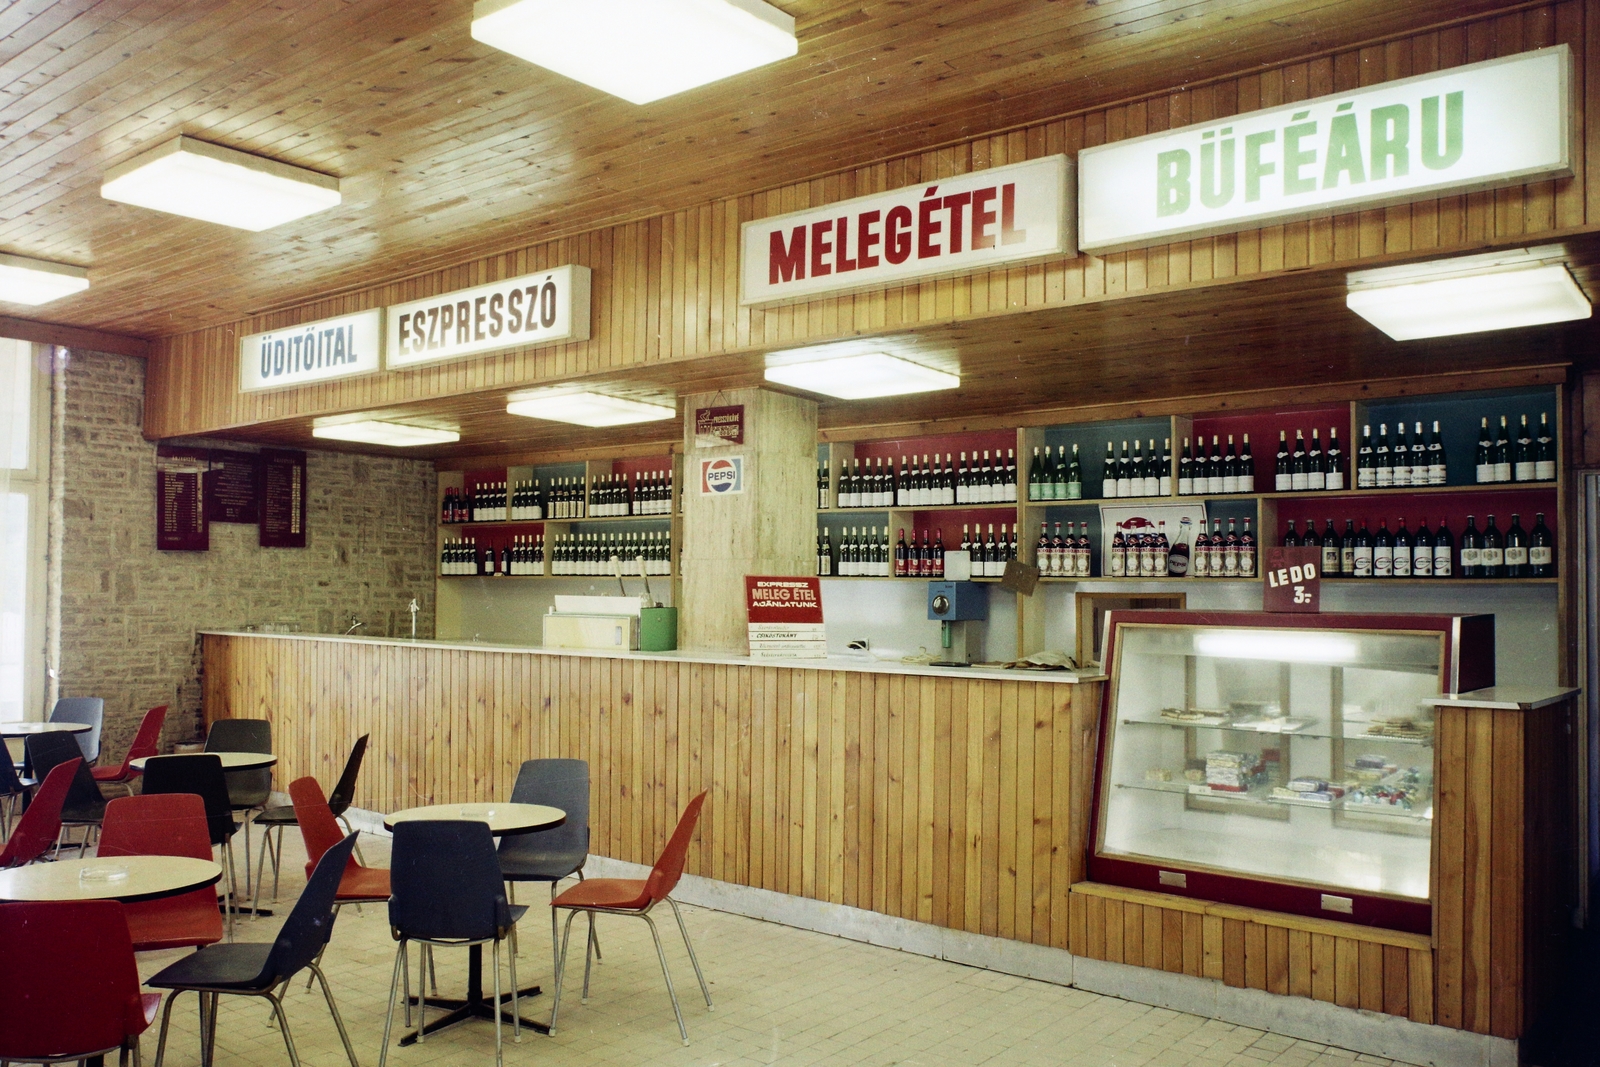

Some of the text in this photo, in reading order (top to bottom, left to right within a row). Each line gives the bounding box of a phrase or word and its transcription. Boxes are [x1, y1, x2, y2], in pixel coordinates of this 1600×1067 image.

[1156, 90, 1465, 218] BÜFÉÁRU
[768, 183, 1027, 286] MELEGÉTEL
[398, 275, 557, 356] ESZPRESSZÓ
[707, 470, 736, 482] PEPSI
[1268, 562, 1316, 588] LEDO
[751, 587, 817, 602] MELEG ÉTEL
[752, 600, 819, 609] AJÁNLATUNK
